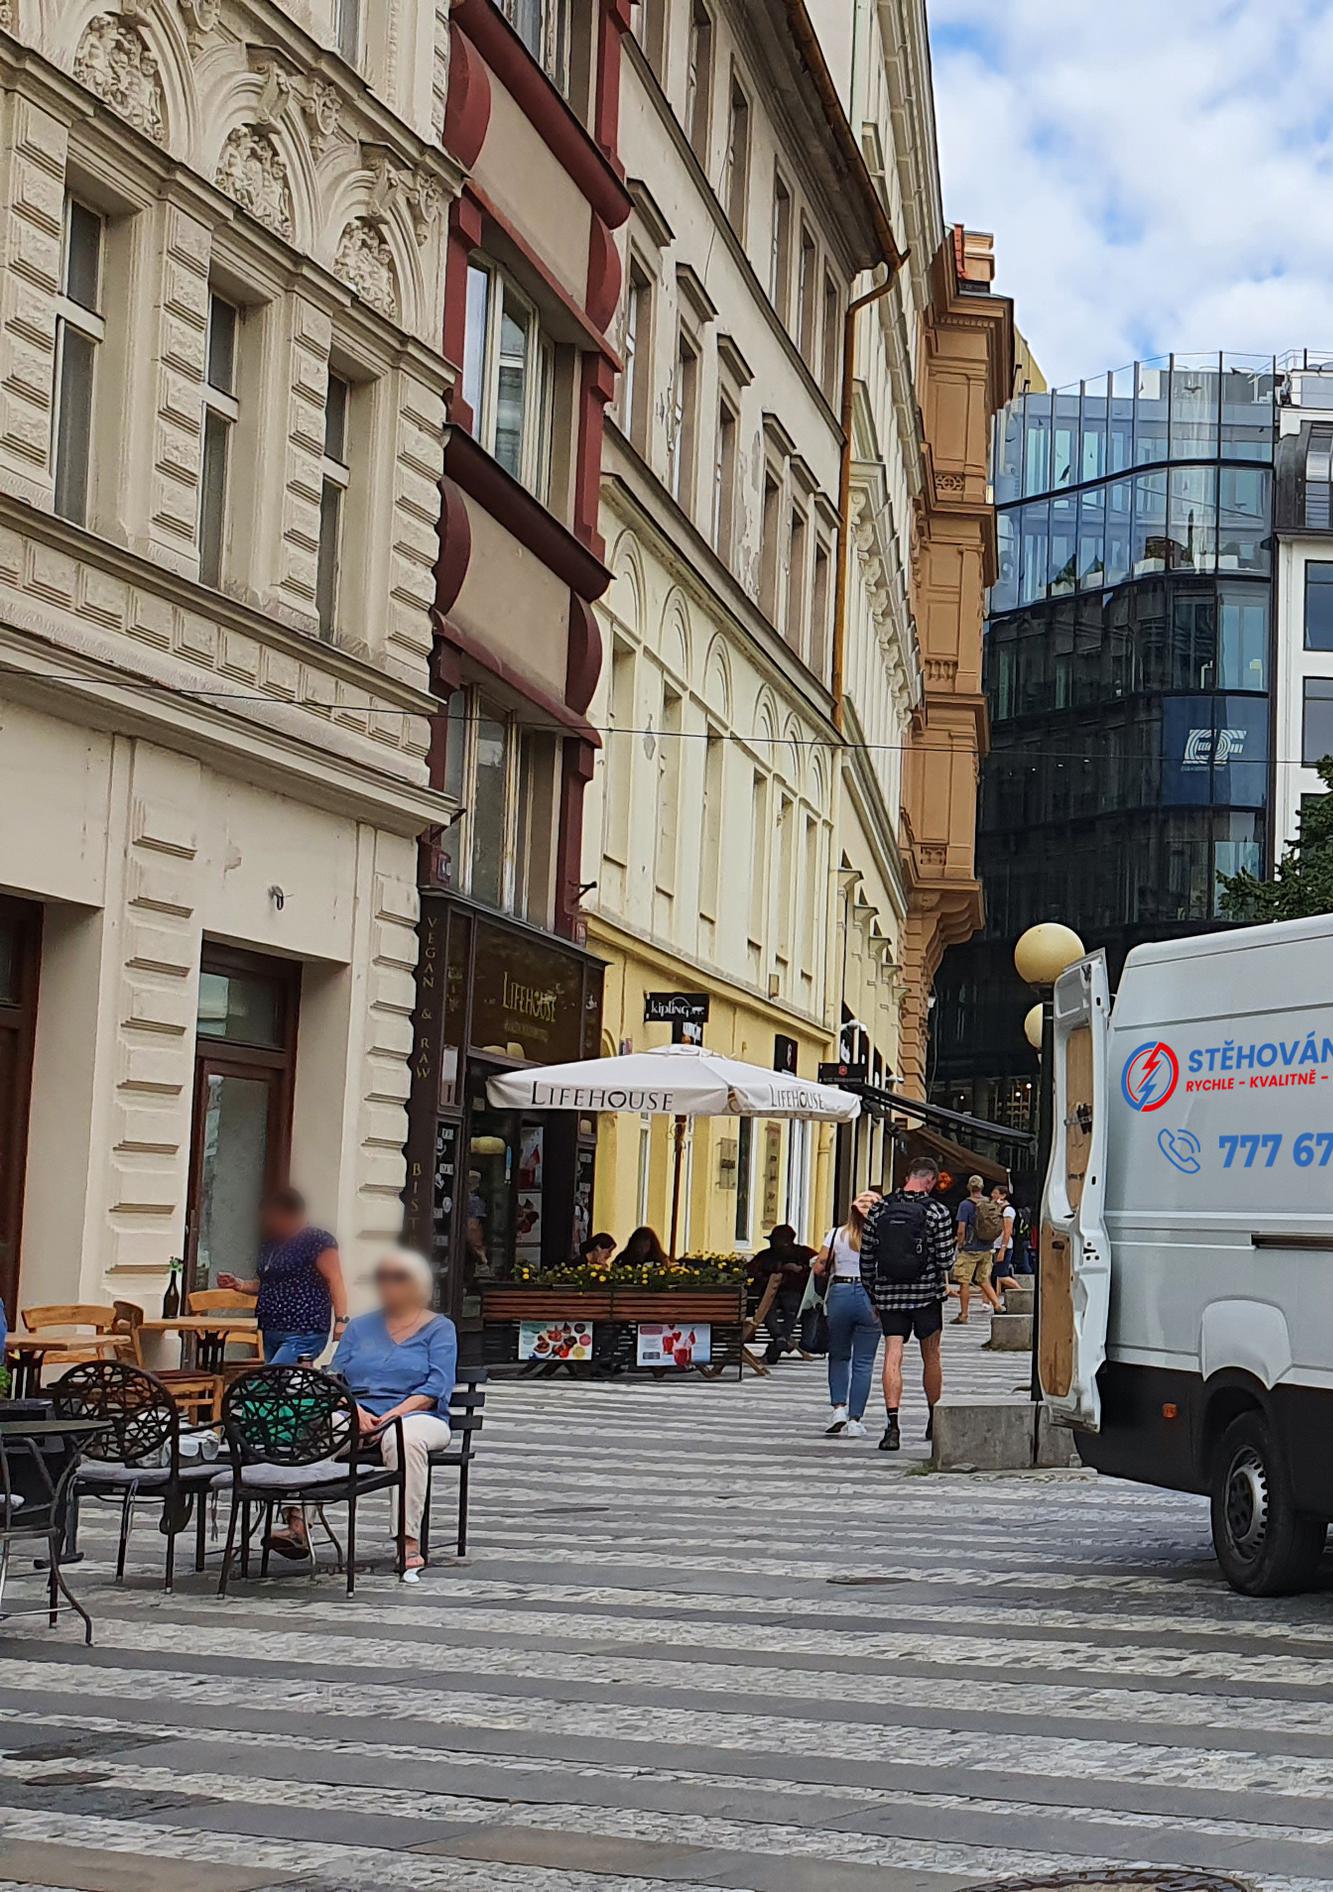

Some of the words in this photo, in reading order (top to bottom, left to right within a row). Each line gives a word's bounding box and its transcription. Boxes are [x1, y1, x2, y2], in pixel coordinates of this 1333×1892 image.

[422, 916, 438, 989] VEGAN
[651, 999, 690, 1018] kipling
[416, 1037, 431, 1080] RAW
[1185, 1077, 1235, 1093] RYCHLE
[1249, 1068, 1317, 1089] KVALITNĚ
[531, 1081, 674, 1112] LIFEHOUSE
[768, 1083, 825, 1111] LIFEHOUSE
[1217, 1133, 1283, 1169] 777
